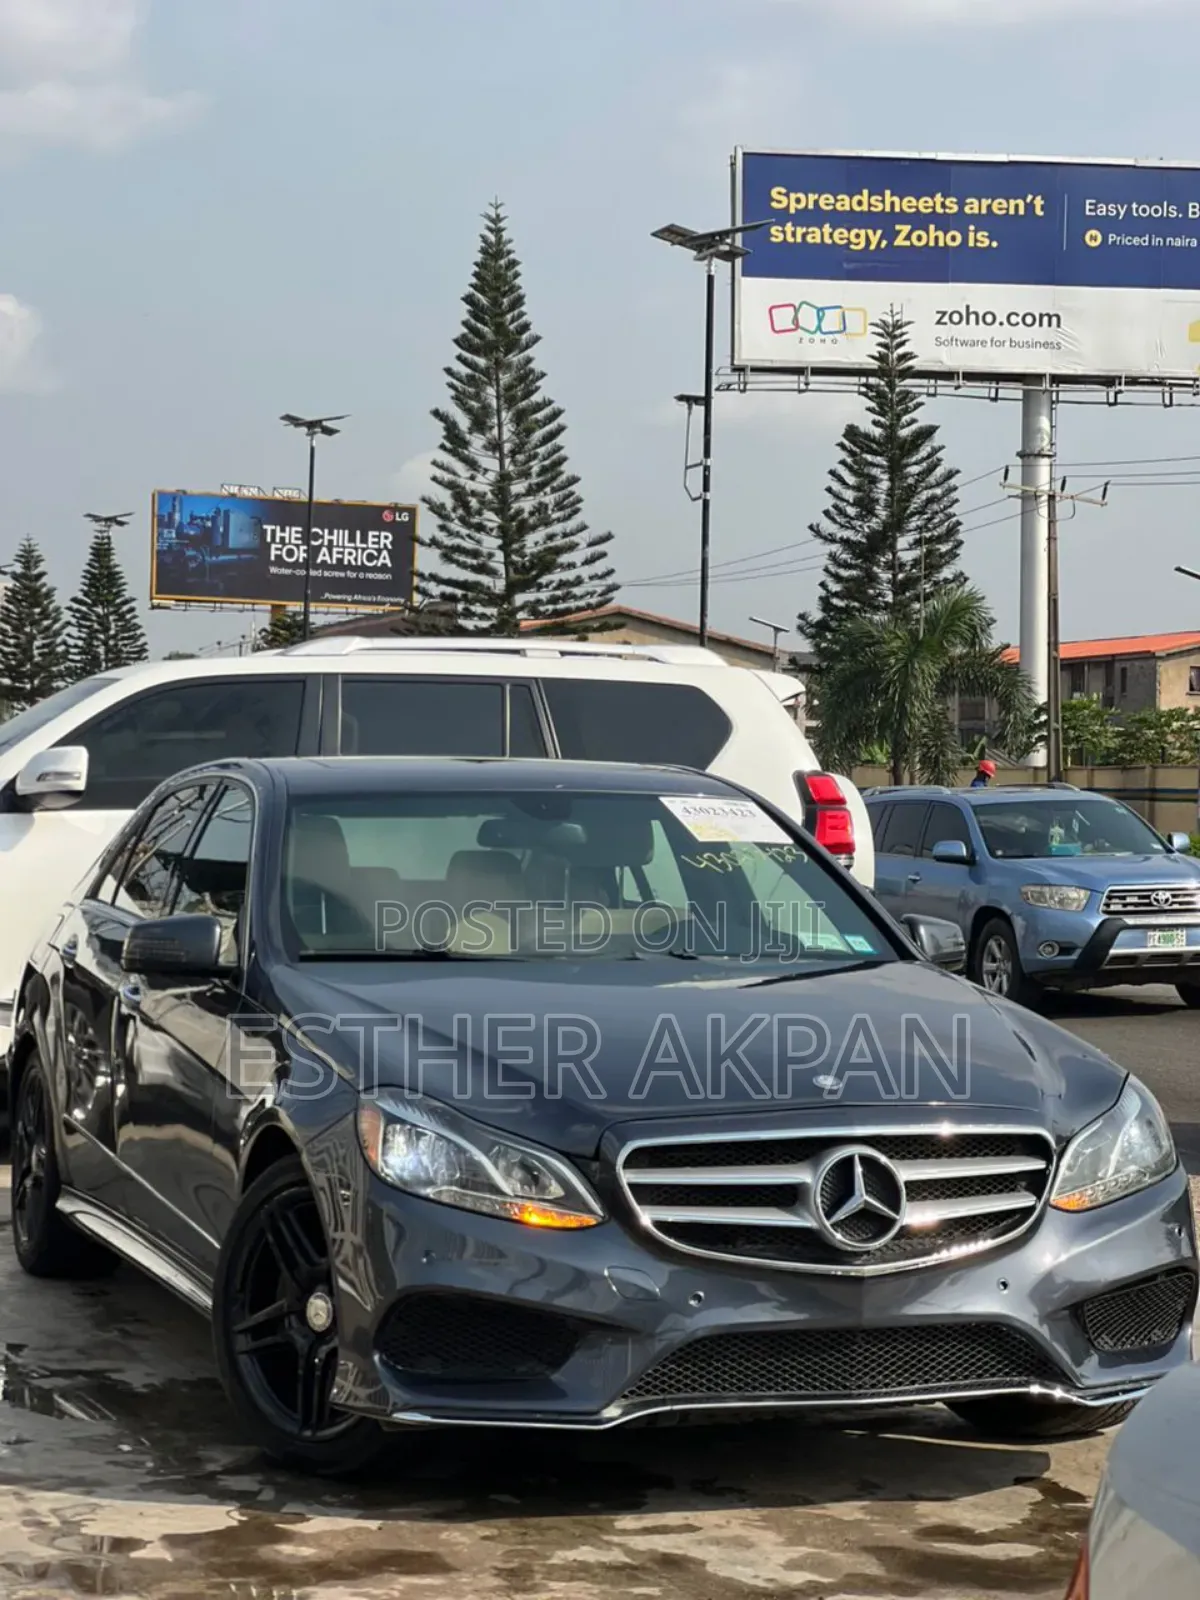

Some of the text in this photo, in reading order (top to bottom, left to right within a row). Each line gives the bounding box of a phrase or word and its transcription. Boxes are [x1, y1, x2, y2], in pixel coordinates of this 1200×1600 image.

[770, 186, 959, 214] Spreadsheets
[1085, 200, 1127, 219] Easy
[1131, 201, 1183, 218] tools.
[769, 221, 998, 250] strategy, Zoho is.
[1108, 234, 1149, 246] Priced
[1151, 235, 1163, 246] in
[1166, 235, 1197, 247] naira
[935, 304, 1061, 328] zoho.com
[935, 336, 1061, 350] Software for business
[395, 512, 409, 521] LG
[263, 525, 392, 549] THE CHILLER
[270, 544, 392, 567] FOR AFRICA
[269, 566, 322, 577] Water-coled
[347, 570, 357, 579] for
